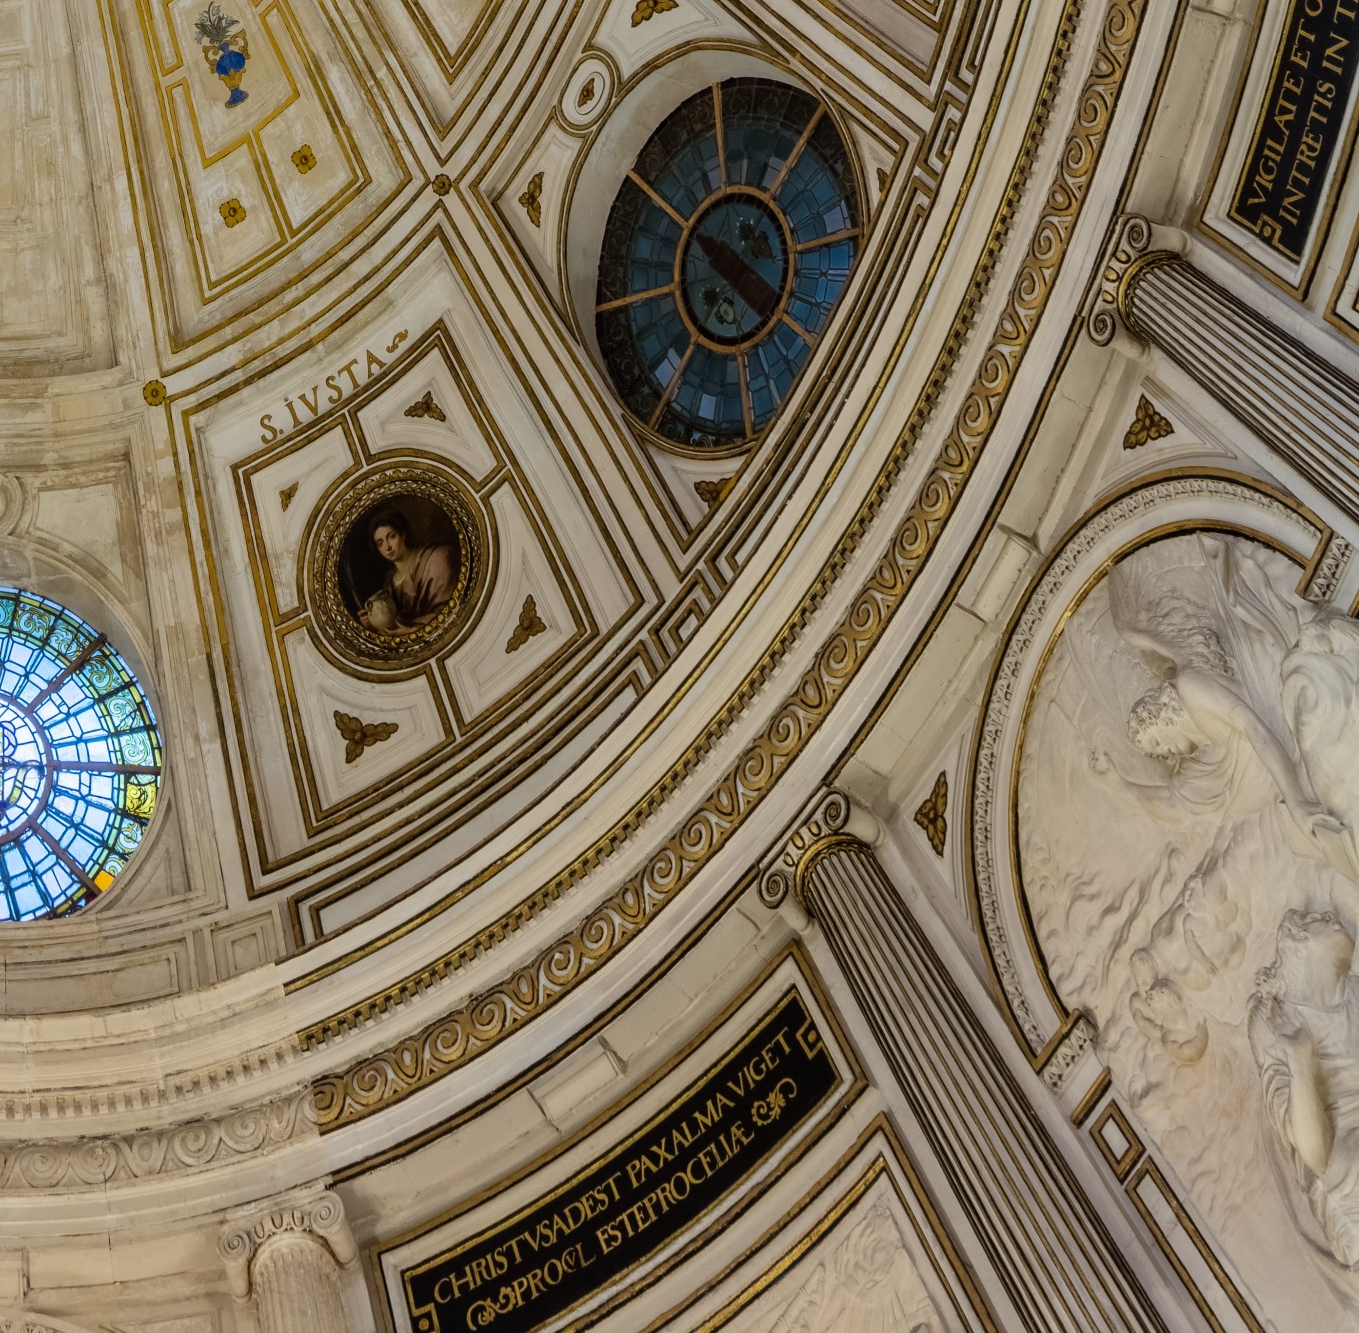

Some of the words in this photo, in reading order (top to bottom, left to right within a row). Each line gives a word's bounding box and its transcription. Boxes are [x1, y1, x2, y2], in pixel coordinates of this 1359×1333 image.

[1247, 70, 1303, 205] VIGILATE
[1290, 18, 1315, 68] ET
[1279, 80, 1335, 225] INTRETIS
[1322, 32, 1349, 75] IN
[260, 414, 284, 445] S.
[284, 349, 388, 428] IVSTA
[432, 1217, 562, 1305] CHRISTVS
[545, 1171, 621, 1237] ADEST
[626, 1137, 677, 1188] PAX
[672, 1093, 735, 1155] ALMA
[727, 1027, 790, 1096] VIGET
